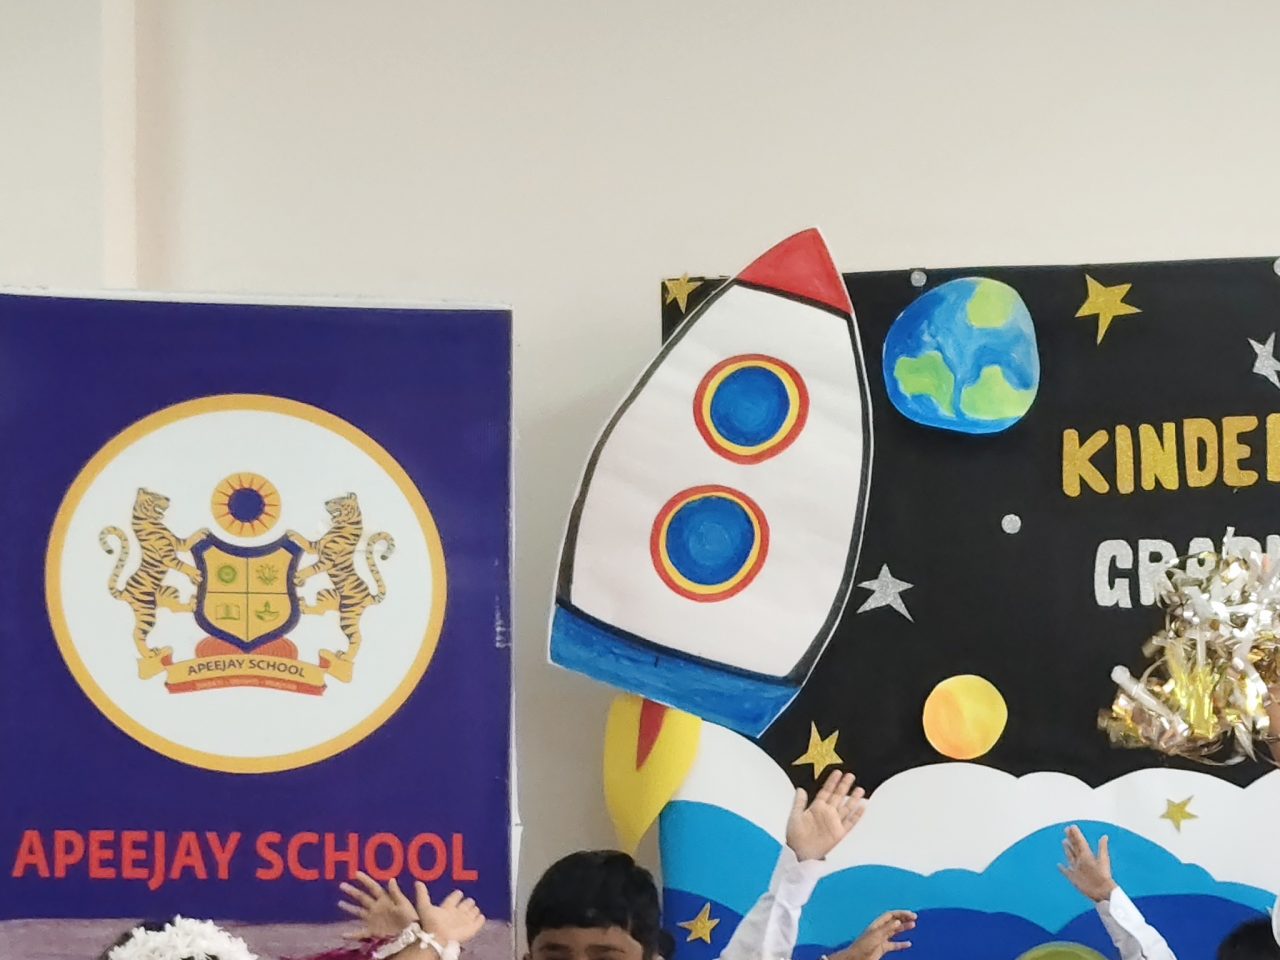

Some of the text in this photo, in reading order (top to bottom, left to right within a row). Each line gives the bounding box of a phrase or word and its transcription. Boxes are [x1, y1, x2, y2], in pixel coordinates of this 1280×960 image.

[188, 659, 305, 678] APEEJAY SCHOOL
[11, 829, 478, 890] APEEJAY SCHOOL
